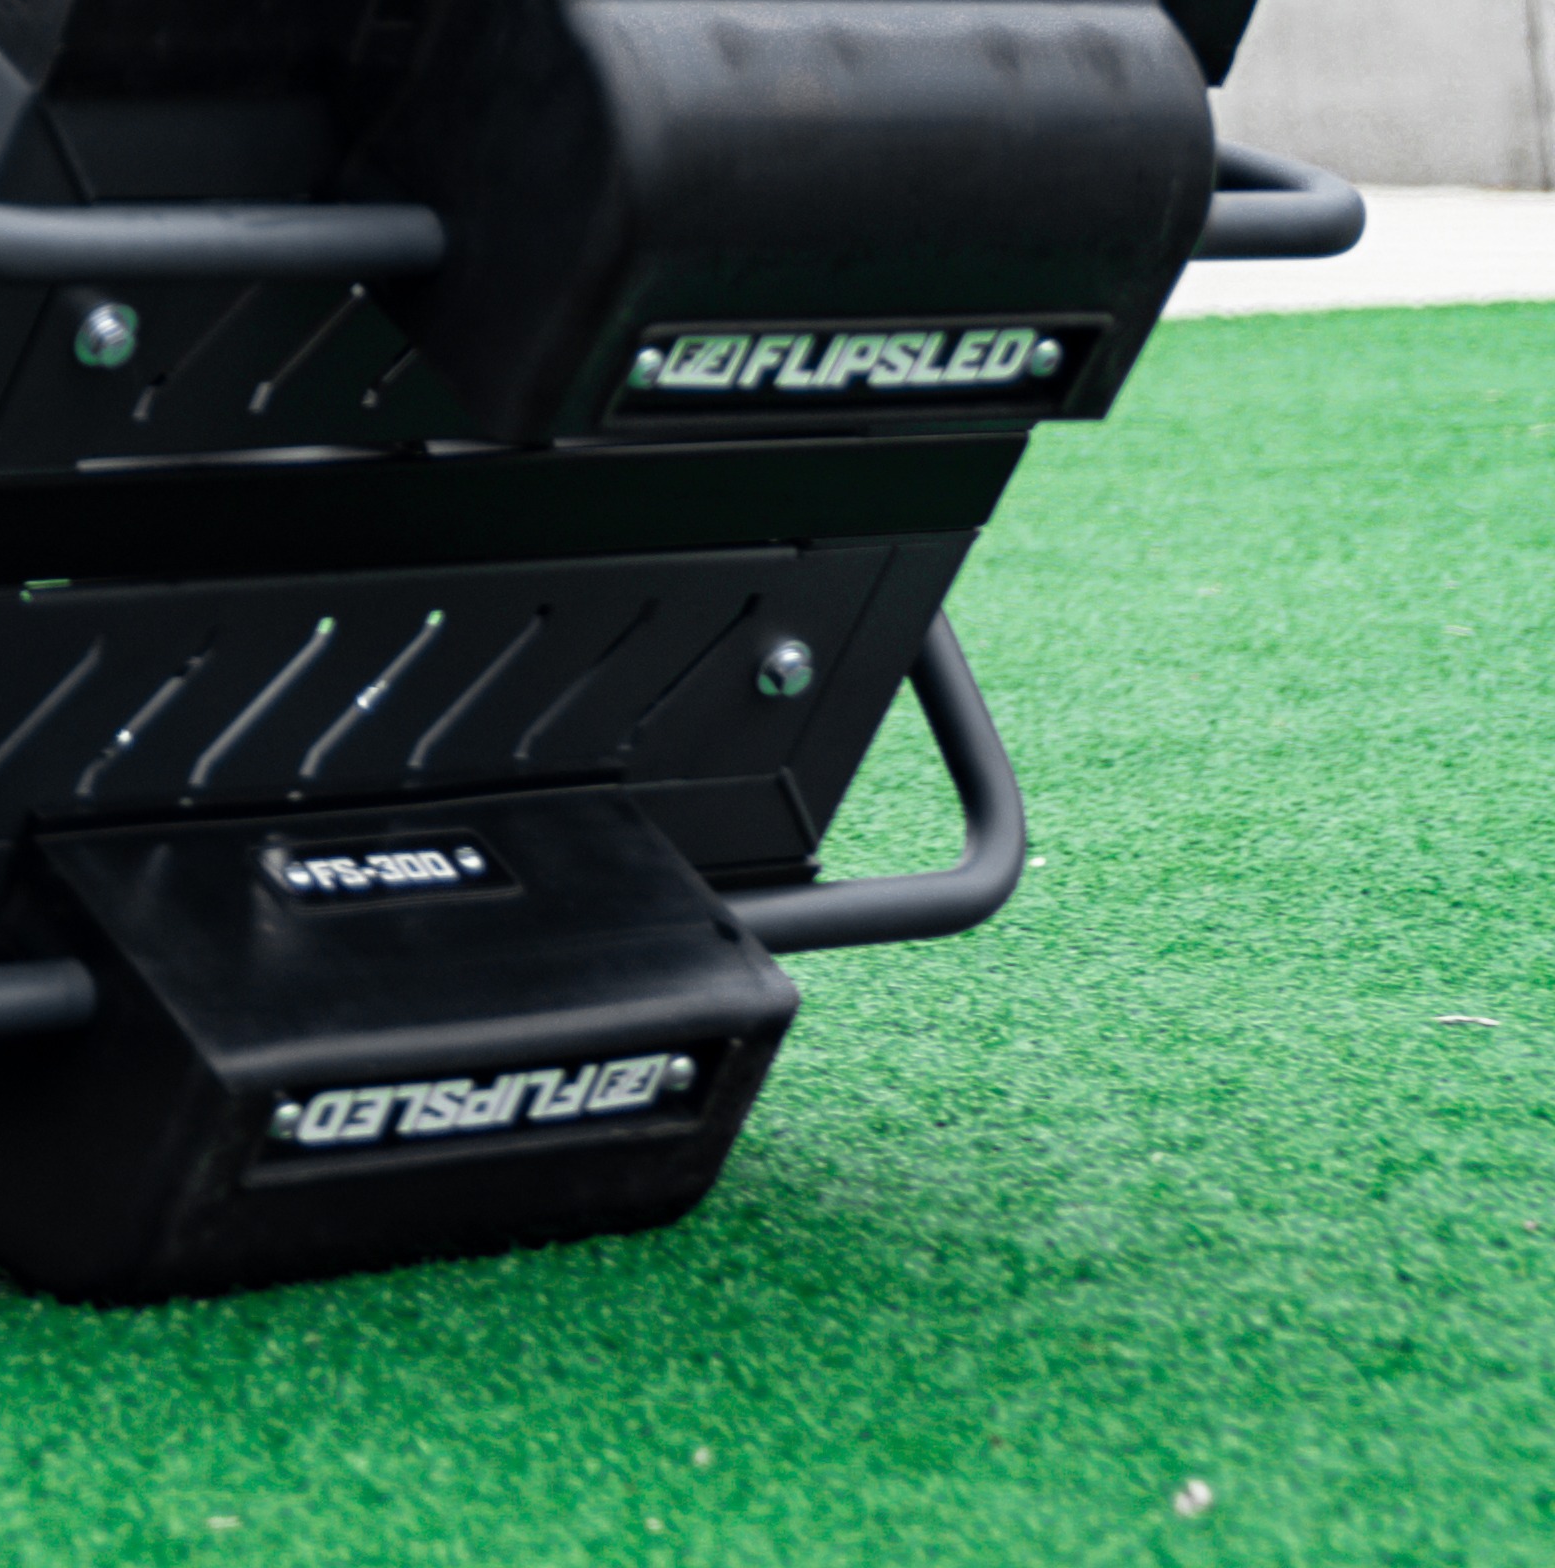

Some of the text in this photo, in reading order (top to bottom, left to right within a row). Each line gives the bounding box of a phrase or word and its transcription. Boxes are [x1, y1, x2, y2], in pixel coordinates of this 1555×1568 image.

[737, 328, 1038, 391] FLIPSLED
[304, 851, 460, 892] FS-300
[295, 1062, 599, 1145] FLIPSLED
